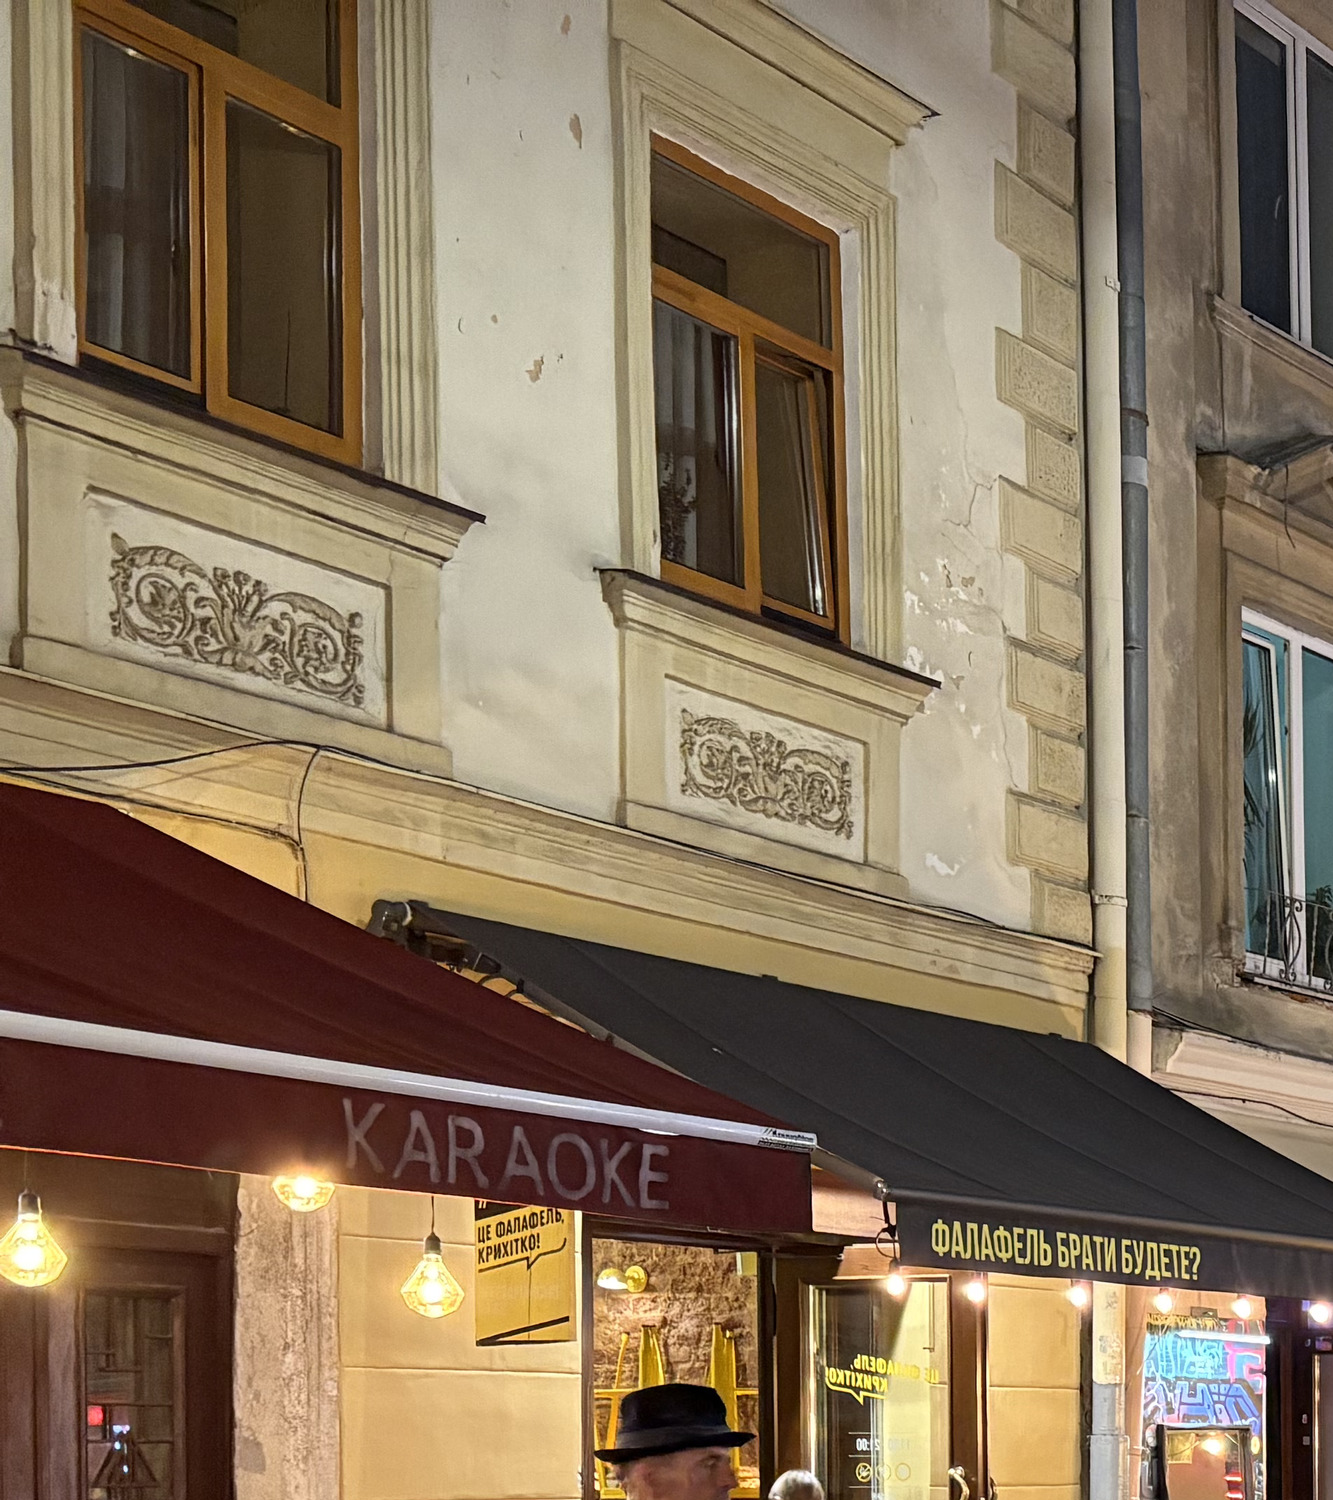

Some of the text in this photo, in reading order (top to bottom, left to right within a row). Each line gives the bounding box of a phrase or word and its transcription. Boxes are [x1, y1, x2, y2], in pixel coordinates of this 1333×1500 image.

[343, 1098, 669, 1210] KARAOKE
[478, 1208, 565, 1244] ЦЕ ФАЛАФЕЛЬ,
[478, 1232, 541, 1265] КРИХІТКО!
[931, 1218, 1201, 1281] ФАЛАФЕЛЬ БРАТИ БУДЕТЕ?
